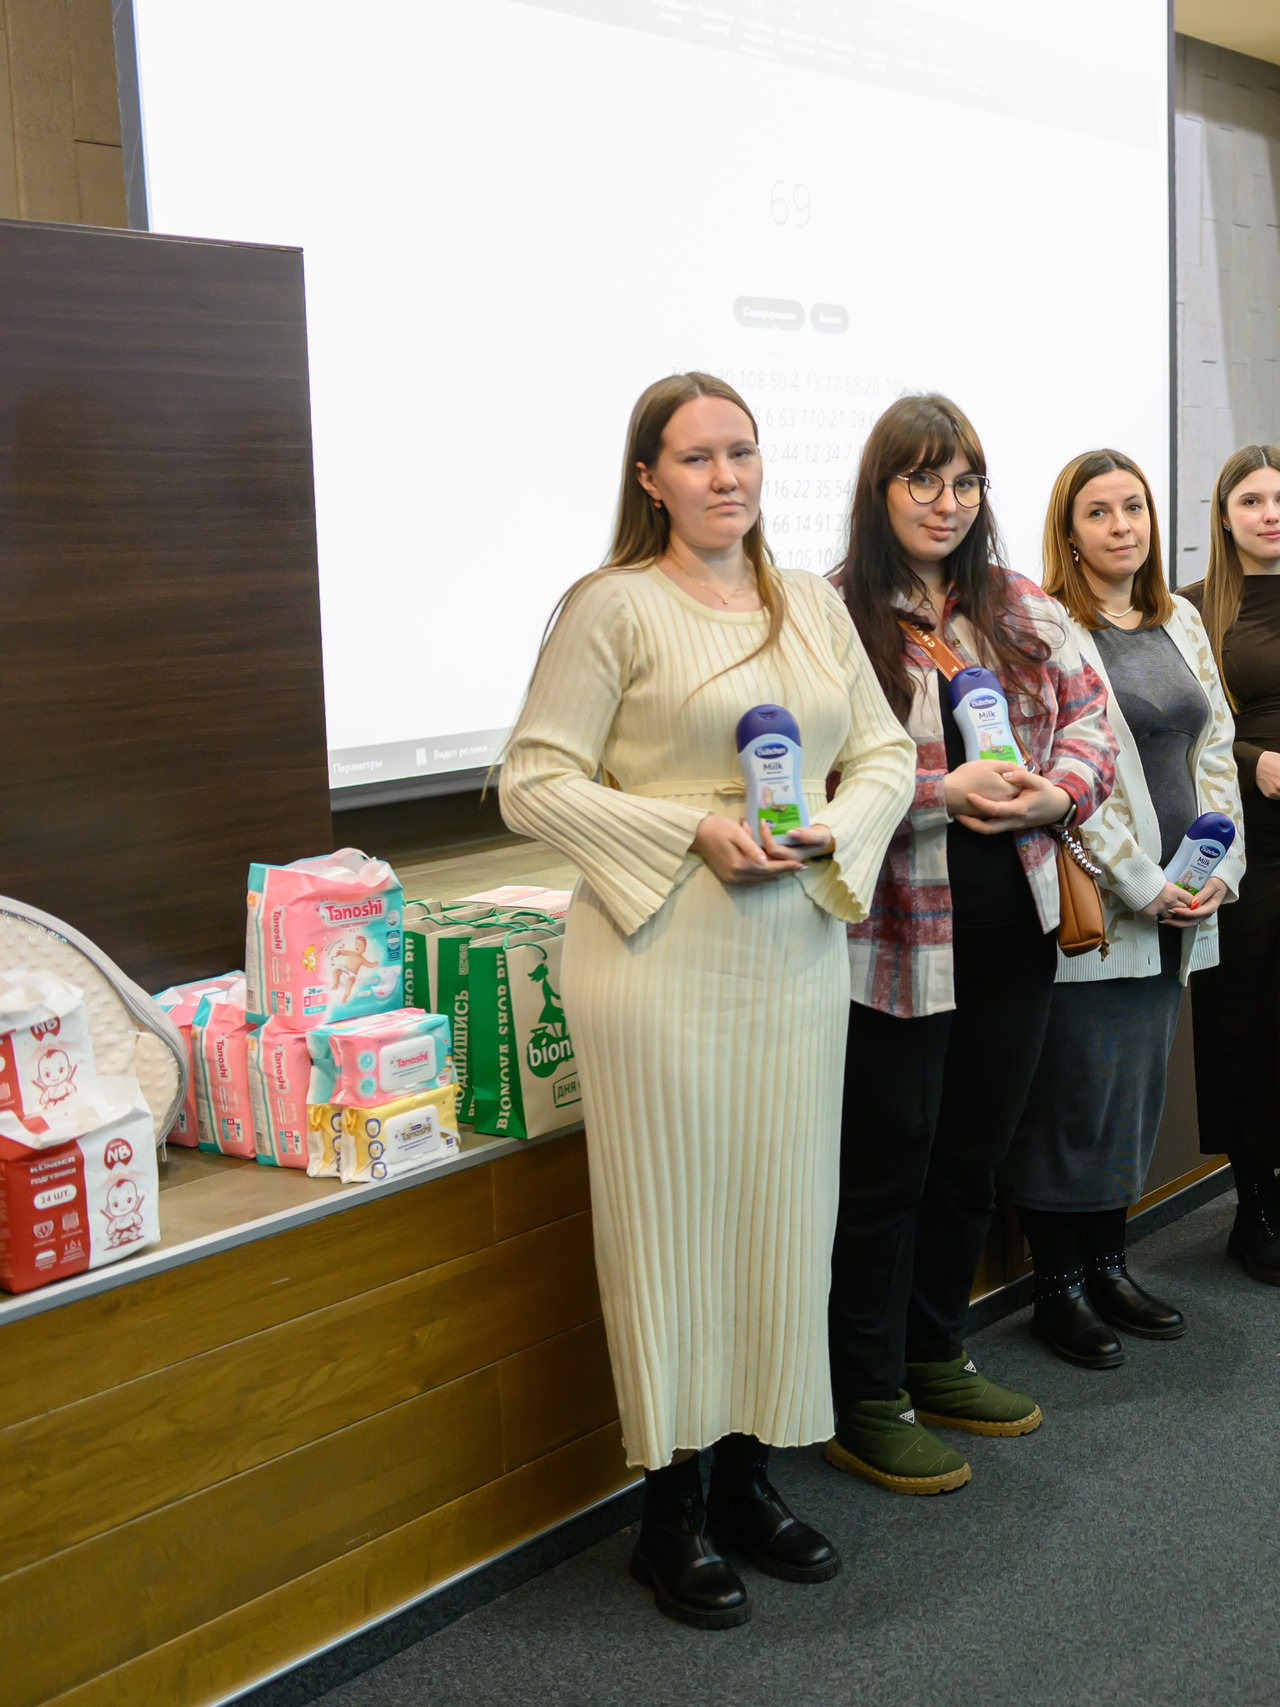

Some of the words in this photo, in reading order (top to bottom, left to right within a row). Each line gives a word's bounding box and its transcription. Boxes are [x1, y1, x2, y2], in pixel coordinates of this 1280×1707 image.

[769, 179, 812, 229] 69
[740, 370, 765, 391] 108
[770, 371, 787, 391] 50
[790, 372, 800, 391] 4
[805, 373, 820, 393] 13
[826, 374, 841, 394] 17
[779, 408, 796, 428] 63
[802, 409, 825, 429] 110
[829, 409, 844, 428] 21
[849, 410, 865, 429] 39
[782, 444, 799, 462] 44
[805, 444, 820, 463] 12
[824, 444, 840, 463] 34
[793, 479, 810, 498] 22
[814, 479, 831, 498] 35
[772, 515, 790, 535] 66
[796, 515, 811, 533] 14
[815, 513, 830, 533] 91
[978, 710, 996, 720] Milk
[333, 759, 383, 775] Параметры
[1197, 856, 1211, 867] Milk
[325, 898, 383, 922] Tanoshi
[273, 910, 283, 950] Tanoshi
[216, 1040, 229, 1079] Tanoshi
[396, 1051, 429, 1069] Tanoshi
[528, 1038, 572, 1067] bion
[274, 1051, 286, 1091] Tanoshi
[106, 1144, 132, 1163] NB
[41, 1196, 52, 1205] 24
